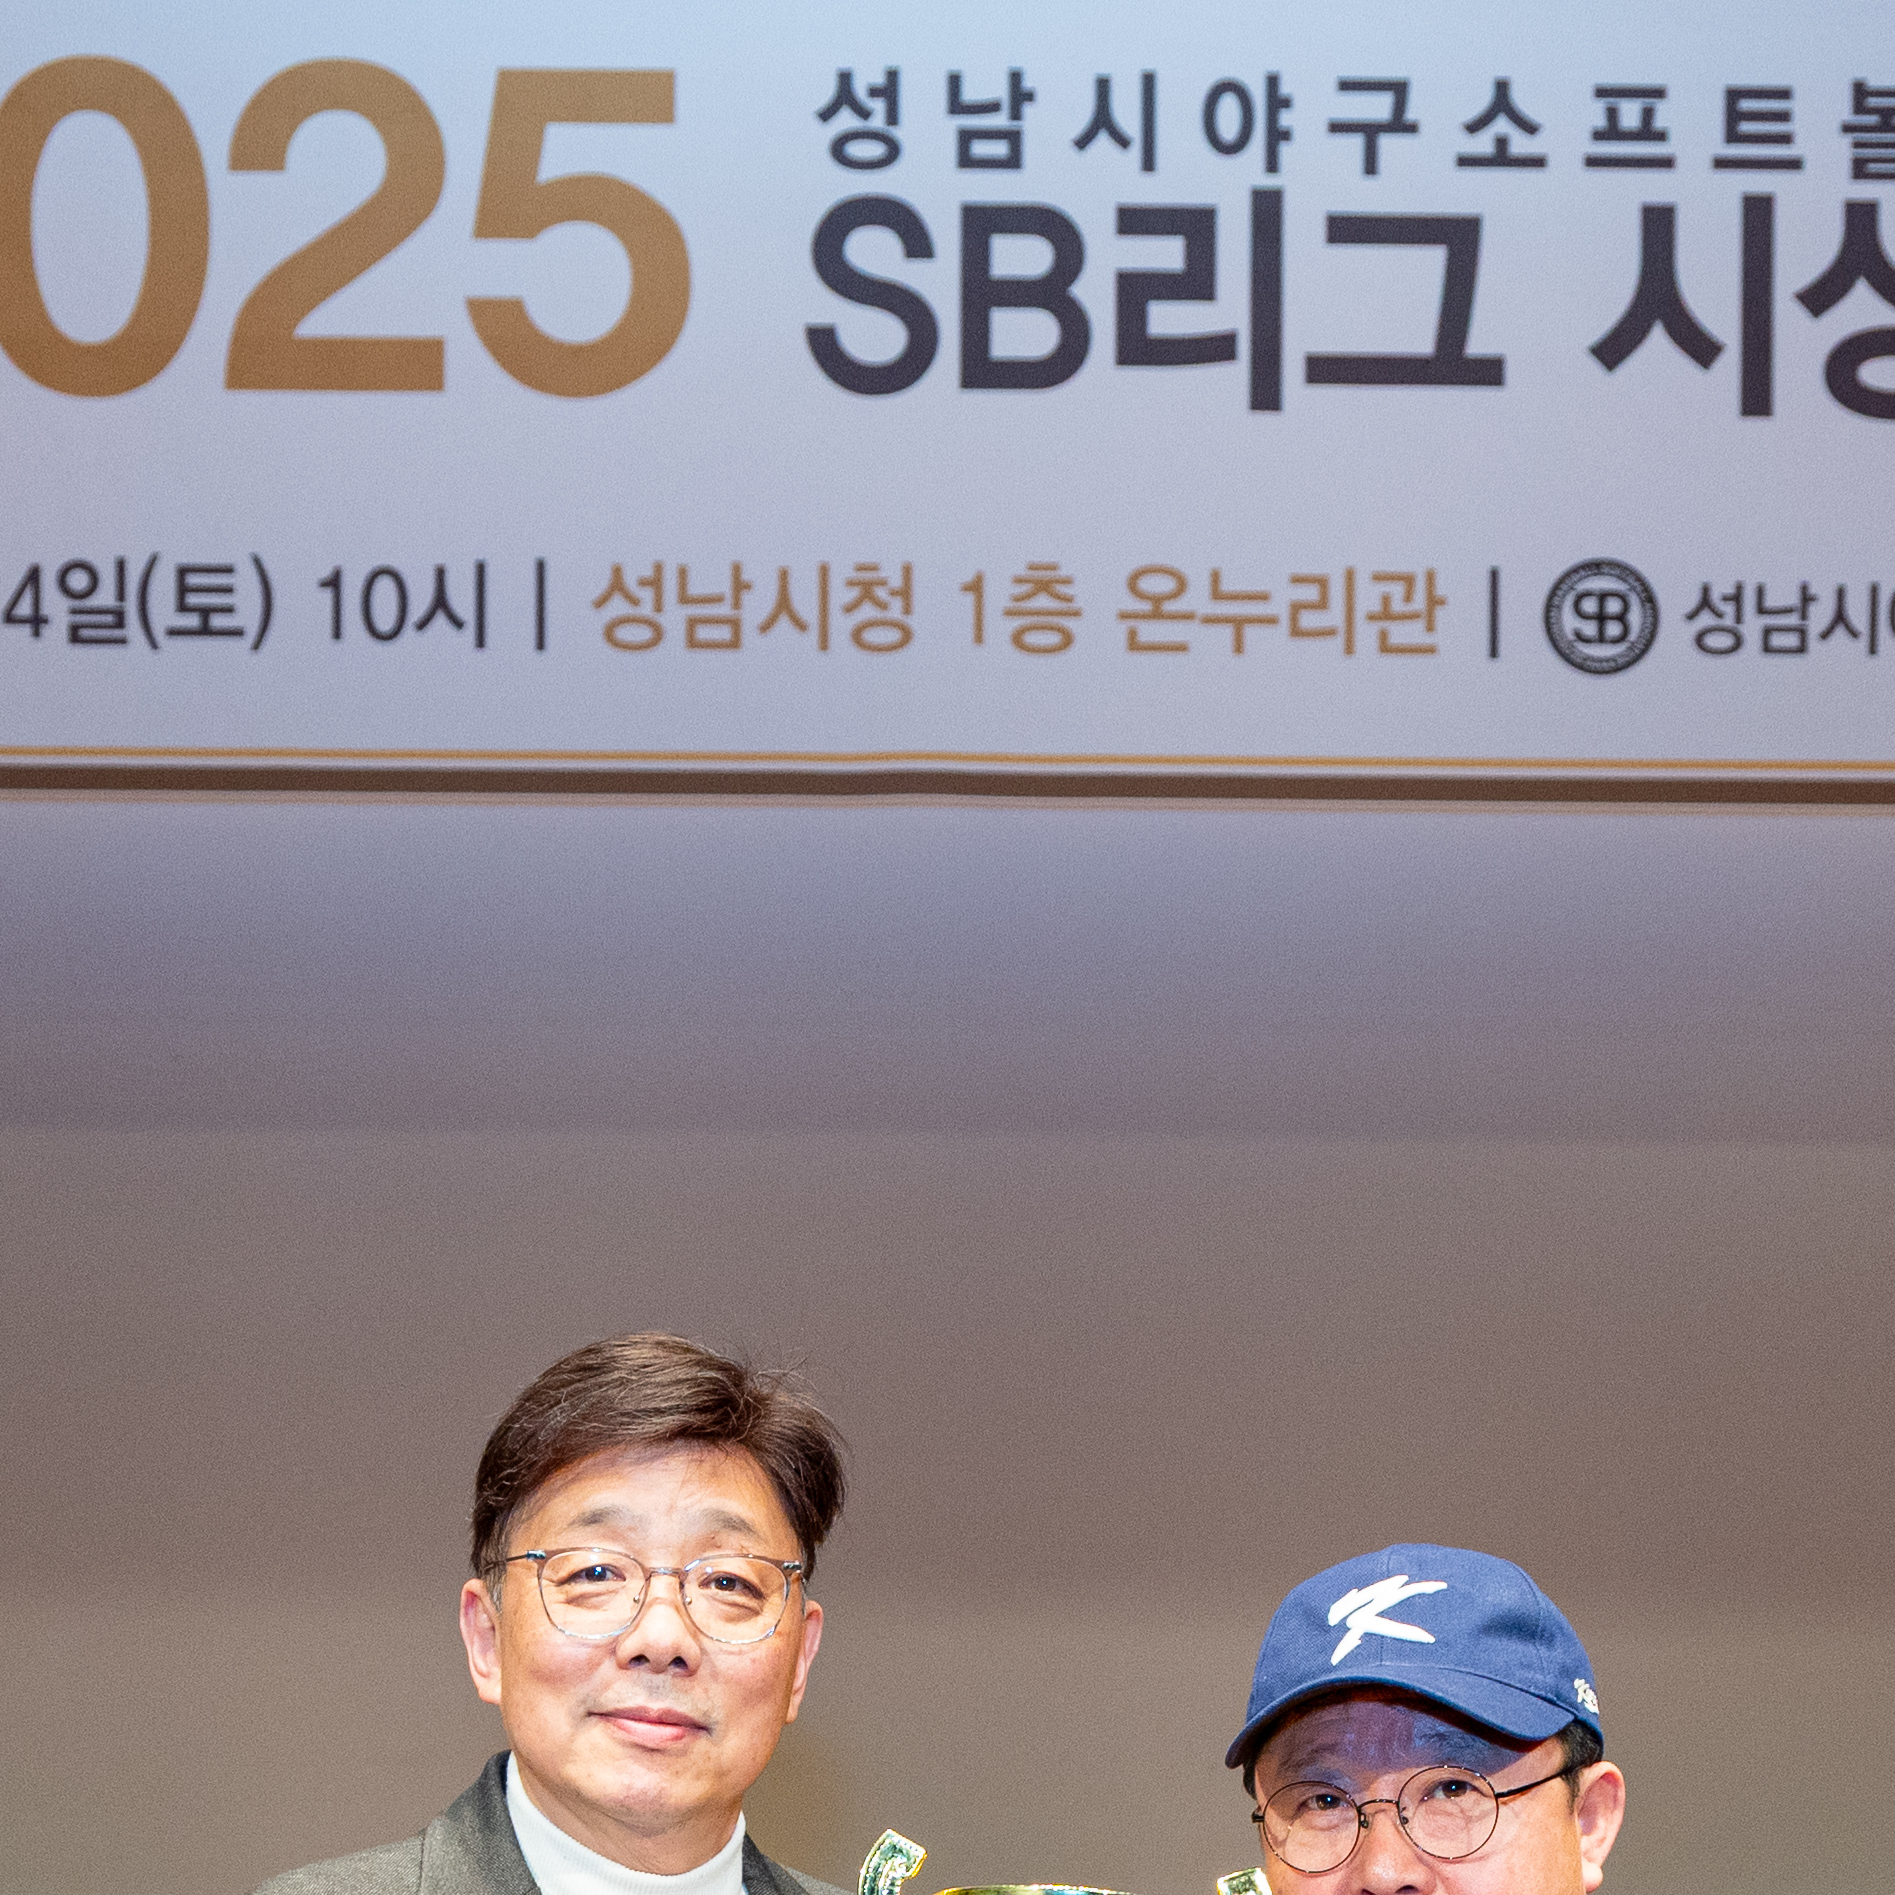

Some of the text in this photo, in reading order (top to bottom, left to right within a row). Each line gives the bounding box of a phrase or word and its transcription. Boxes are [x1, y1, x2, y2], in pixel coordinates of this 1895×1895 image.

[805, 188, 1506, 413] SB리그
[316, 560, 489, 650] 10시
[591, 562, 915, 653] 성남시청
[960, 563, 1083, 655] 1층
[1118, 566, 1446, 655] 온누리관
